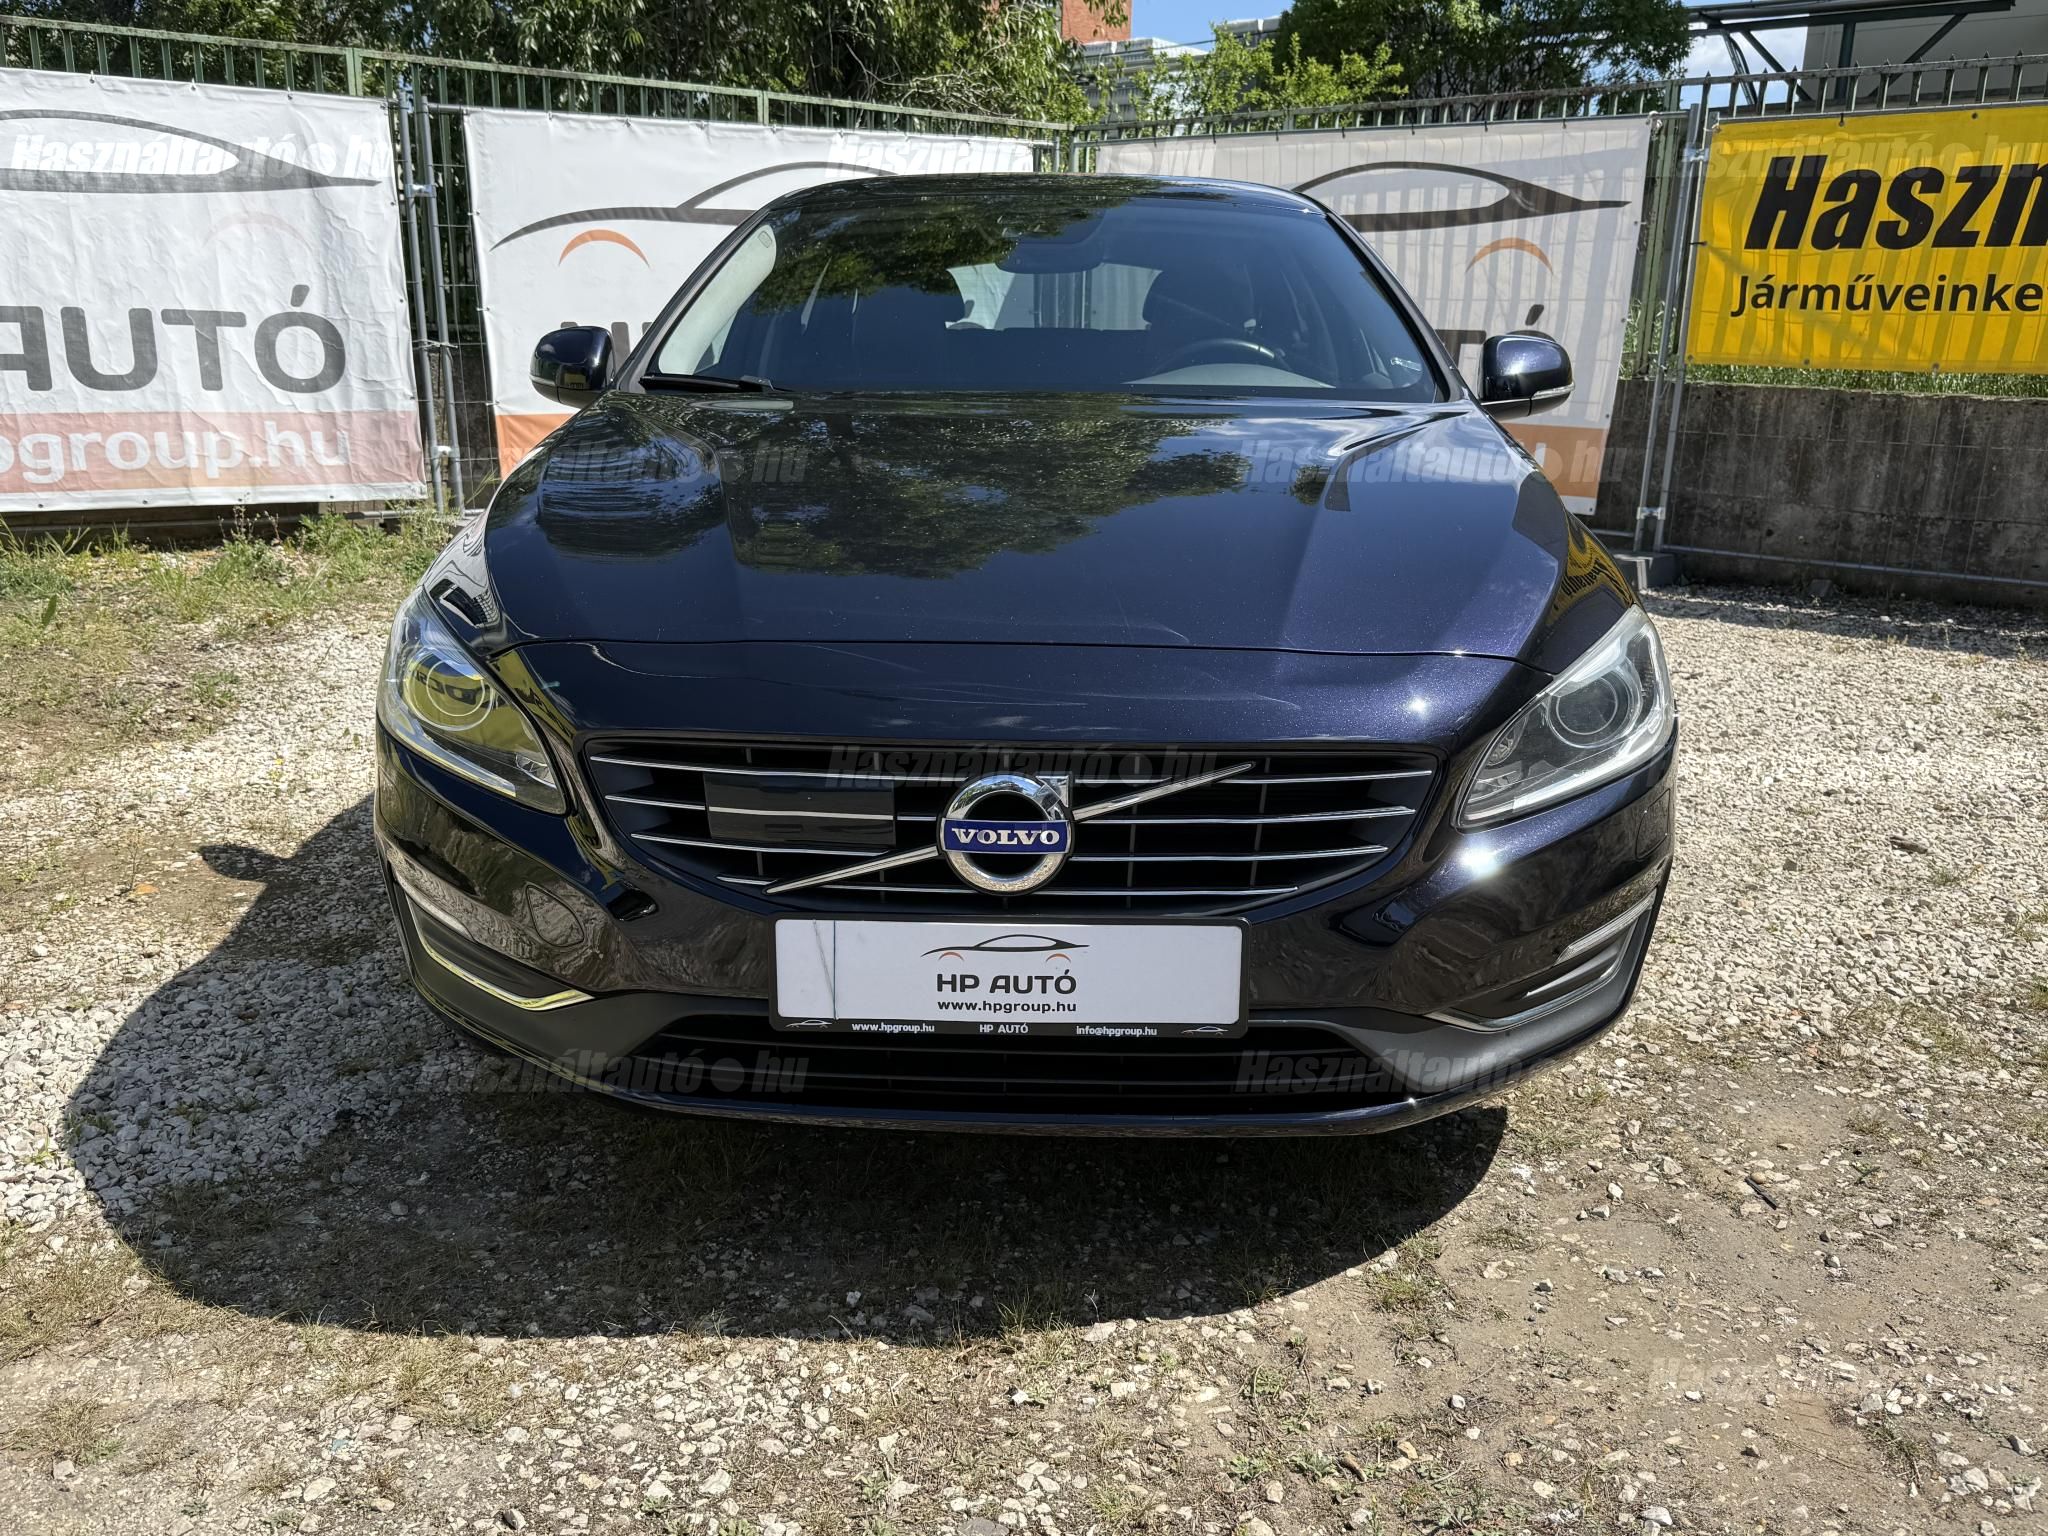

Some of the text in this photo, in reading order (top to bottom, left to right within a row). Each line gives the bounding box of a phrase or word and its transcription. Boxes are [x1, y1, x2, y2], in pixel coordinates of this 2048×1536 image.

[1730, 273, 2048, 318] Járműveinke
[0, 420, 349, 484] group.hu
[951, 827, 1060, 845] VOLVO
[936, 968, 1077, 995] HP AUTÓ
[937, 1000, 1077, 1014] www.hpgroup.hu
[851, 1021, 935, 1034] www.hpgroup.hu
[979, 1021, 1029, 1034] HP AUTÓ
